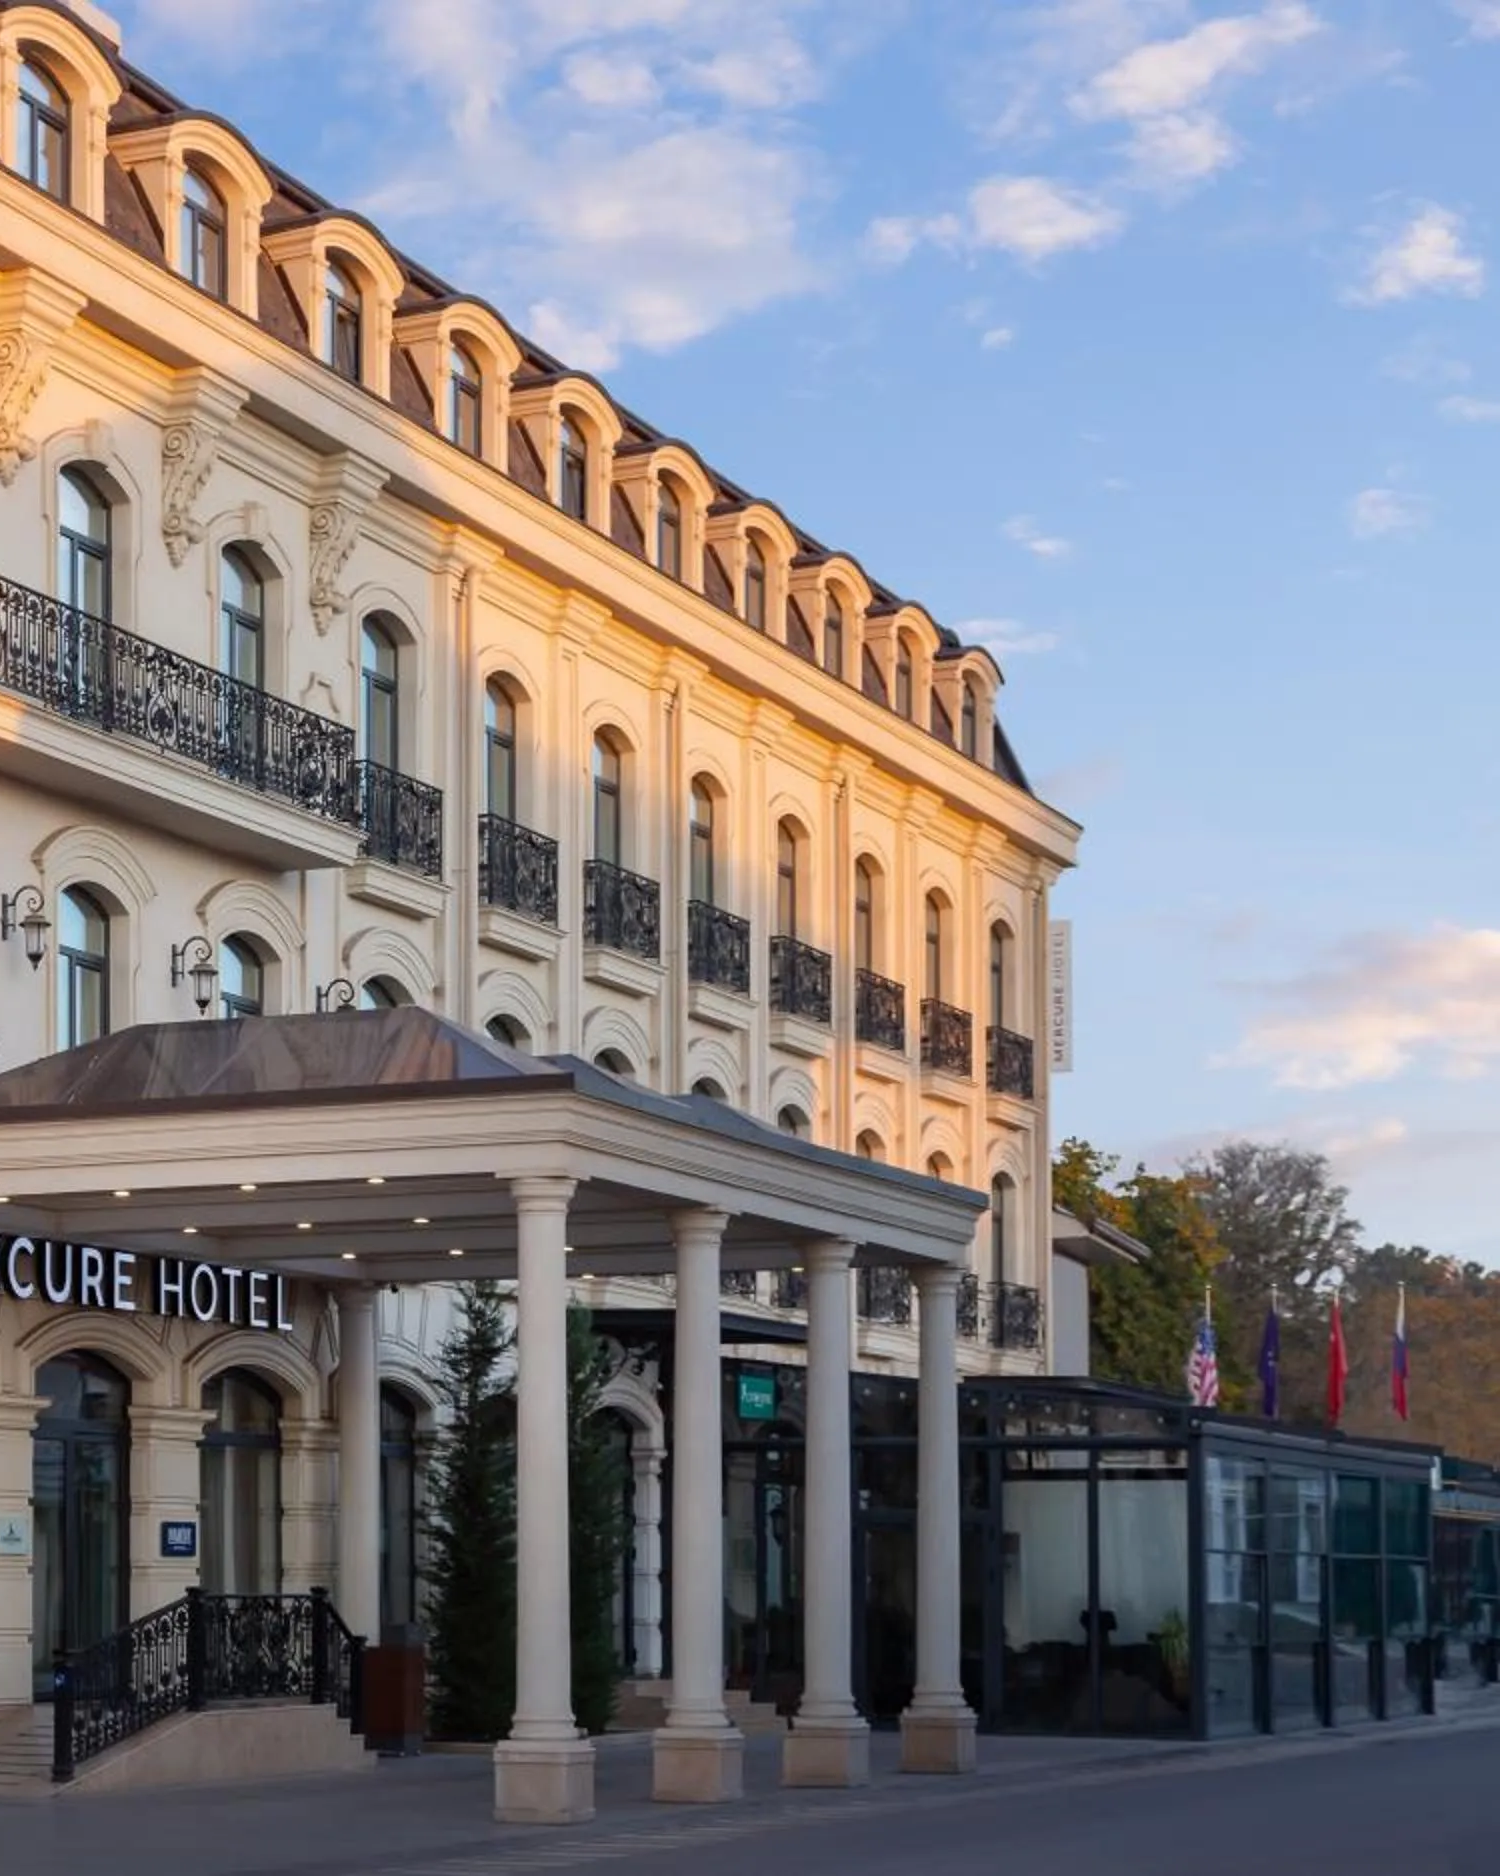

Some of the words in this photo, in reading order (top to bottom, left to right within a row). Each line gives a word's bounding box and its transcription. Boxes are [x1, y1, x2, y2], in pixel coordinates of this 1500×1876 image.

[1052, 931, 1064, 979] HOTEL
[1053, 987, 1064, 1062] MERCURE
[160, 1257, 294, 1332] HOTEL
